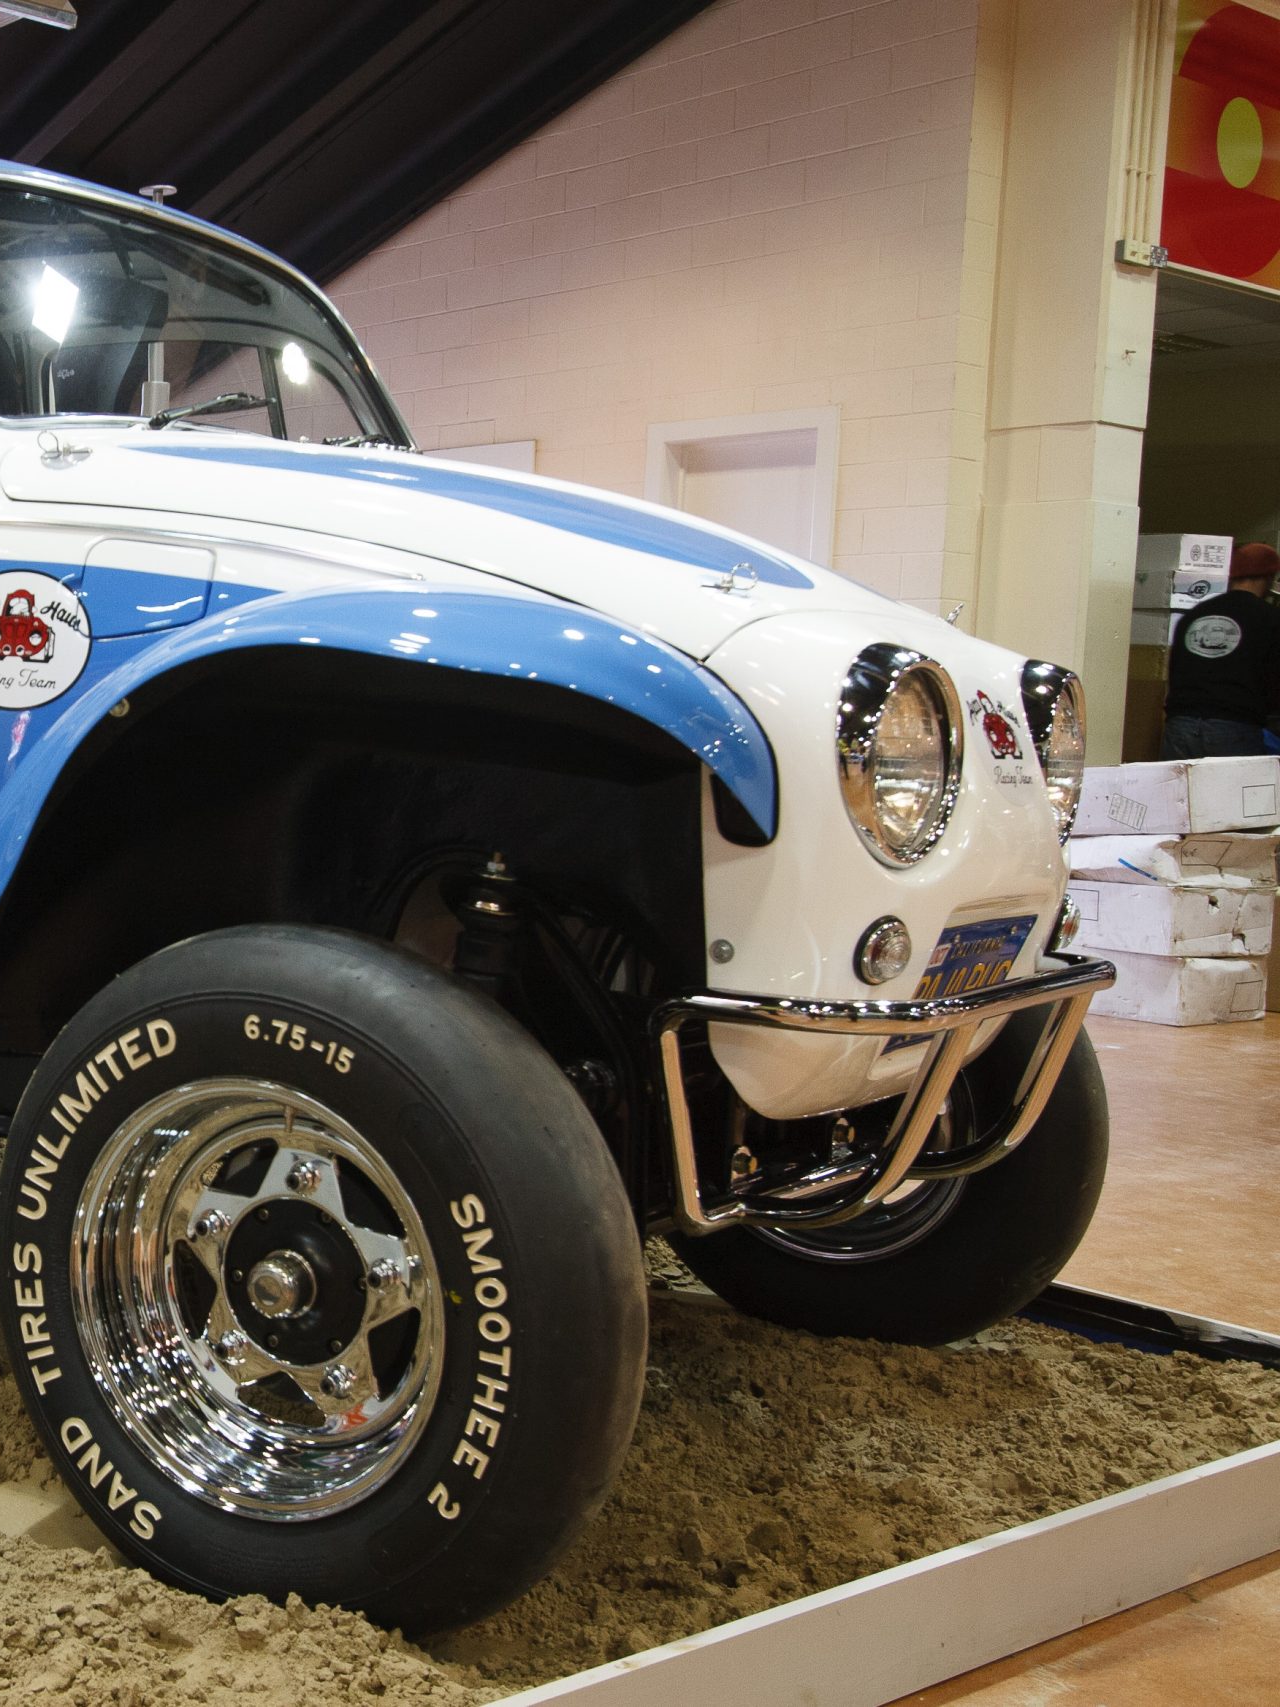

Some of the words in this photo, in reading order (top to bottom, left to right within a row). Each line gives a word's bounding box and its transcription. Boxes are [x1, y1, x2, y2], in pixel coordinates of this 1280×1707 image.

[40, 600, 81, 631] Haus
[18, 668, 57, 689] Team
[242, 1013, 356, 1076] 6.75-15
[16, 1017, 178, 1221] UNLIMITED
[13, 1241, 62, 1396] TIRES
[450, 1192, 512, 1481] SMOOTHEE
[60, 1415, 163, 1541] SAND
[426, 1481, 462, 1521] 2
